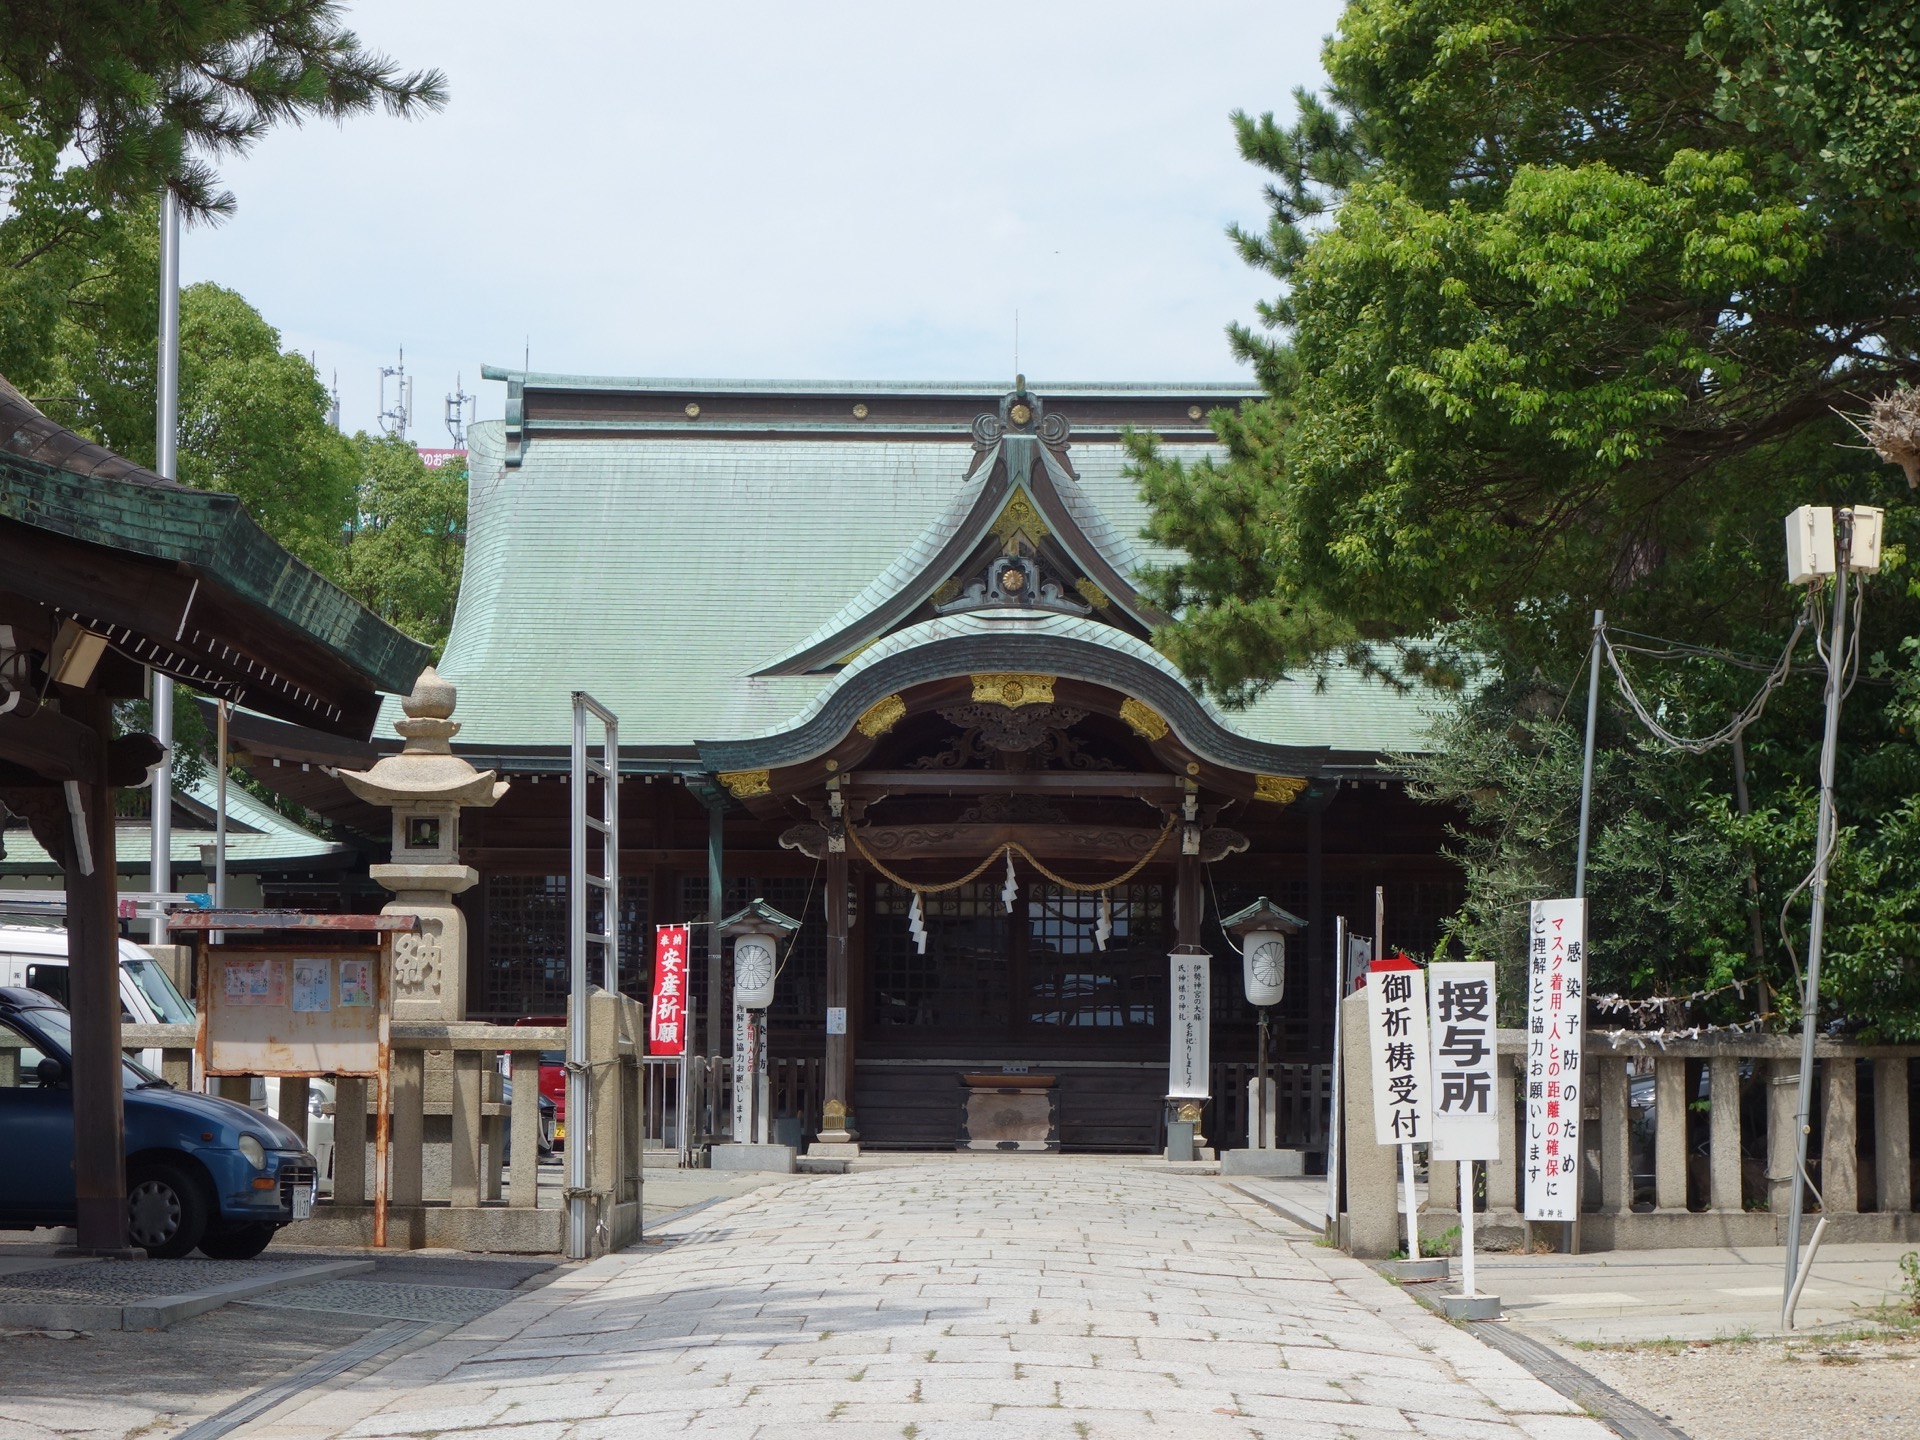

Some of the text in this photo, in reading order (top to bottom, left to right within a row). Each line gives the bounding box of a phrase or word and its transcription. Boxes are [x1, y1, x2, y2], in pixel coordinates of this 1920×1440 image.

[657, 947, 682, 1044] 安産祈願
[660, 934, 682, 946] 奉納
[1178, 964, 1186, 1021] 氏神様の神札
[1193, 964, 1201, 1021] 伊勢神宮の大麻
[1185, 1022, 1194, 1088] をお祀りしましょう
[1381, 973, 1420, 1139] 御祈祷受付
[1438, 980, 1491, 1113] 授与所
[1528, 918, 1546, 1183] ご理解とご協力お願いします
[1546, 918, 1564, 1196] マスク着用・人との距離の確保に
[1562, 941, 1582, 1174] 感染予防のため
